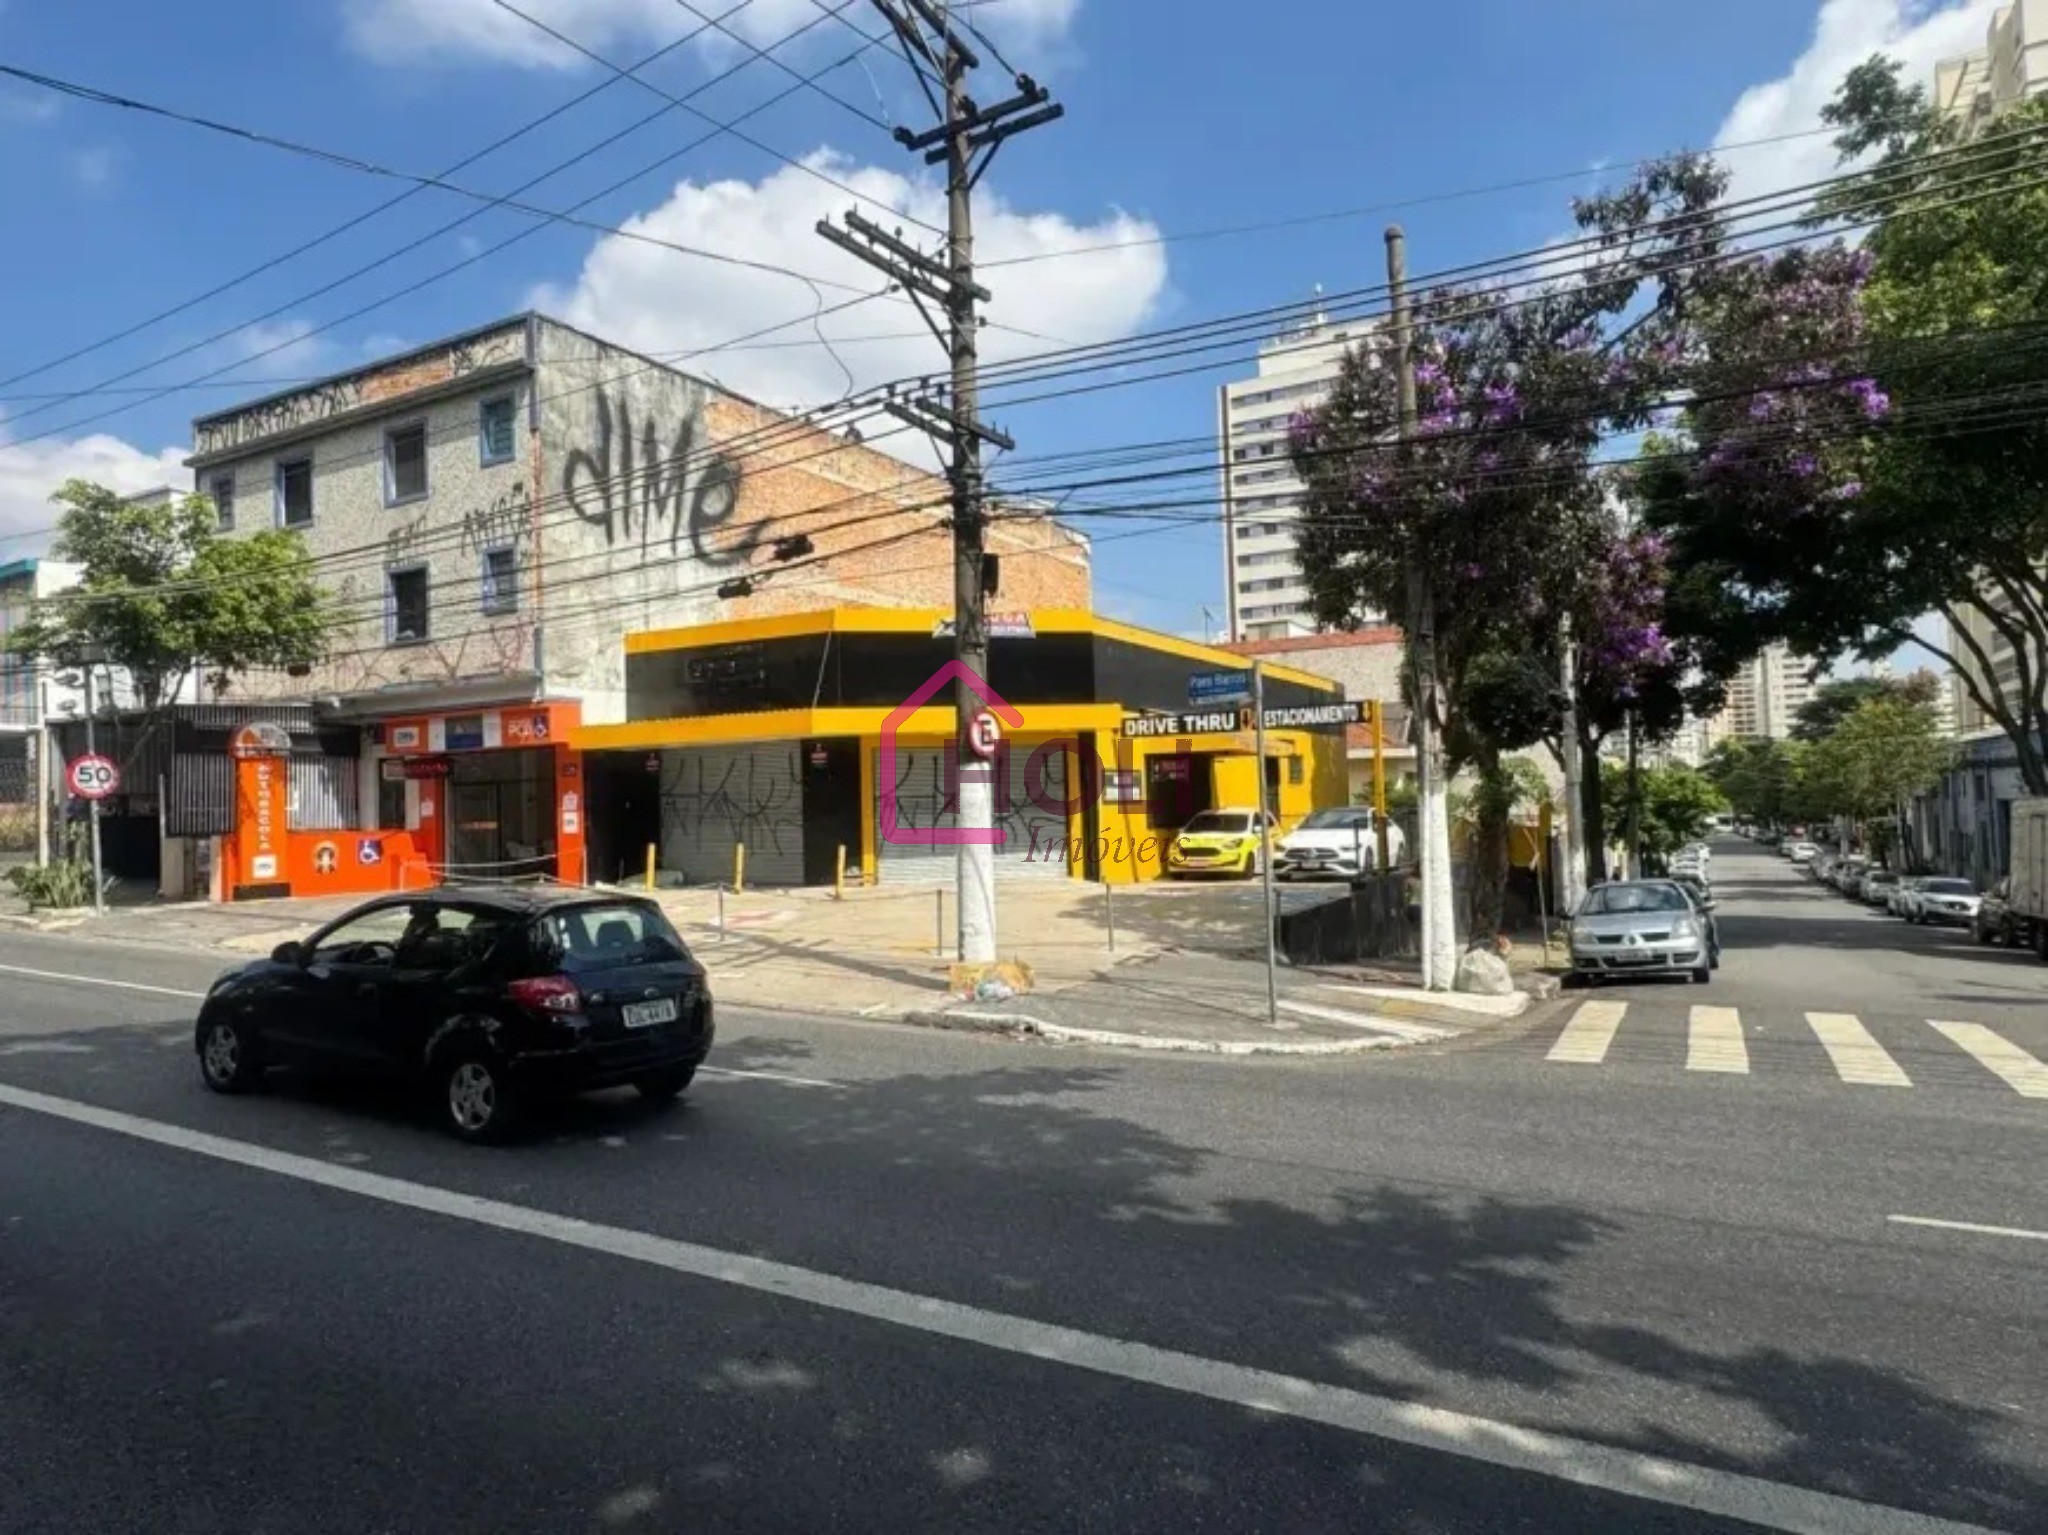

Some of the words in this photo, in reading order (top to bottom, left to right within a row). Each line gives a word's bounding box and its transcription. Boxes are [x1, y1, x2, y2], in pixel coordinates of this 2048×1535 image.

[1125, 718, 1178, 735] DRIVE
[1183, 712, 1235, 731] THRU
[1264, 705, 1358, 727] ESTACIONAMENTO
[78, 765, 112, 782] 50
